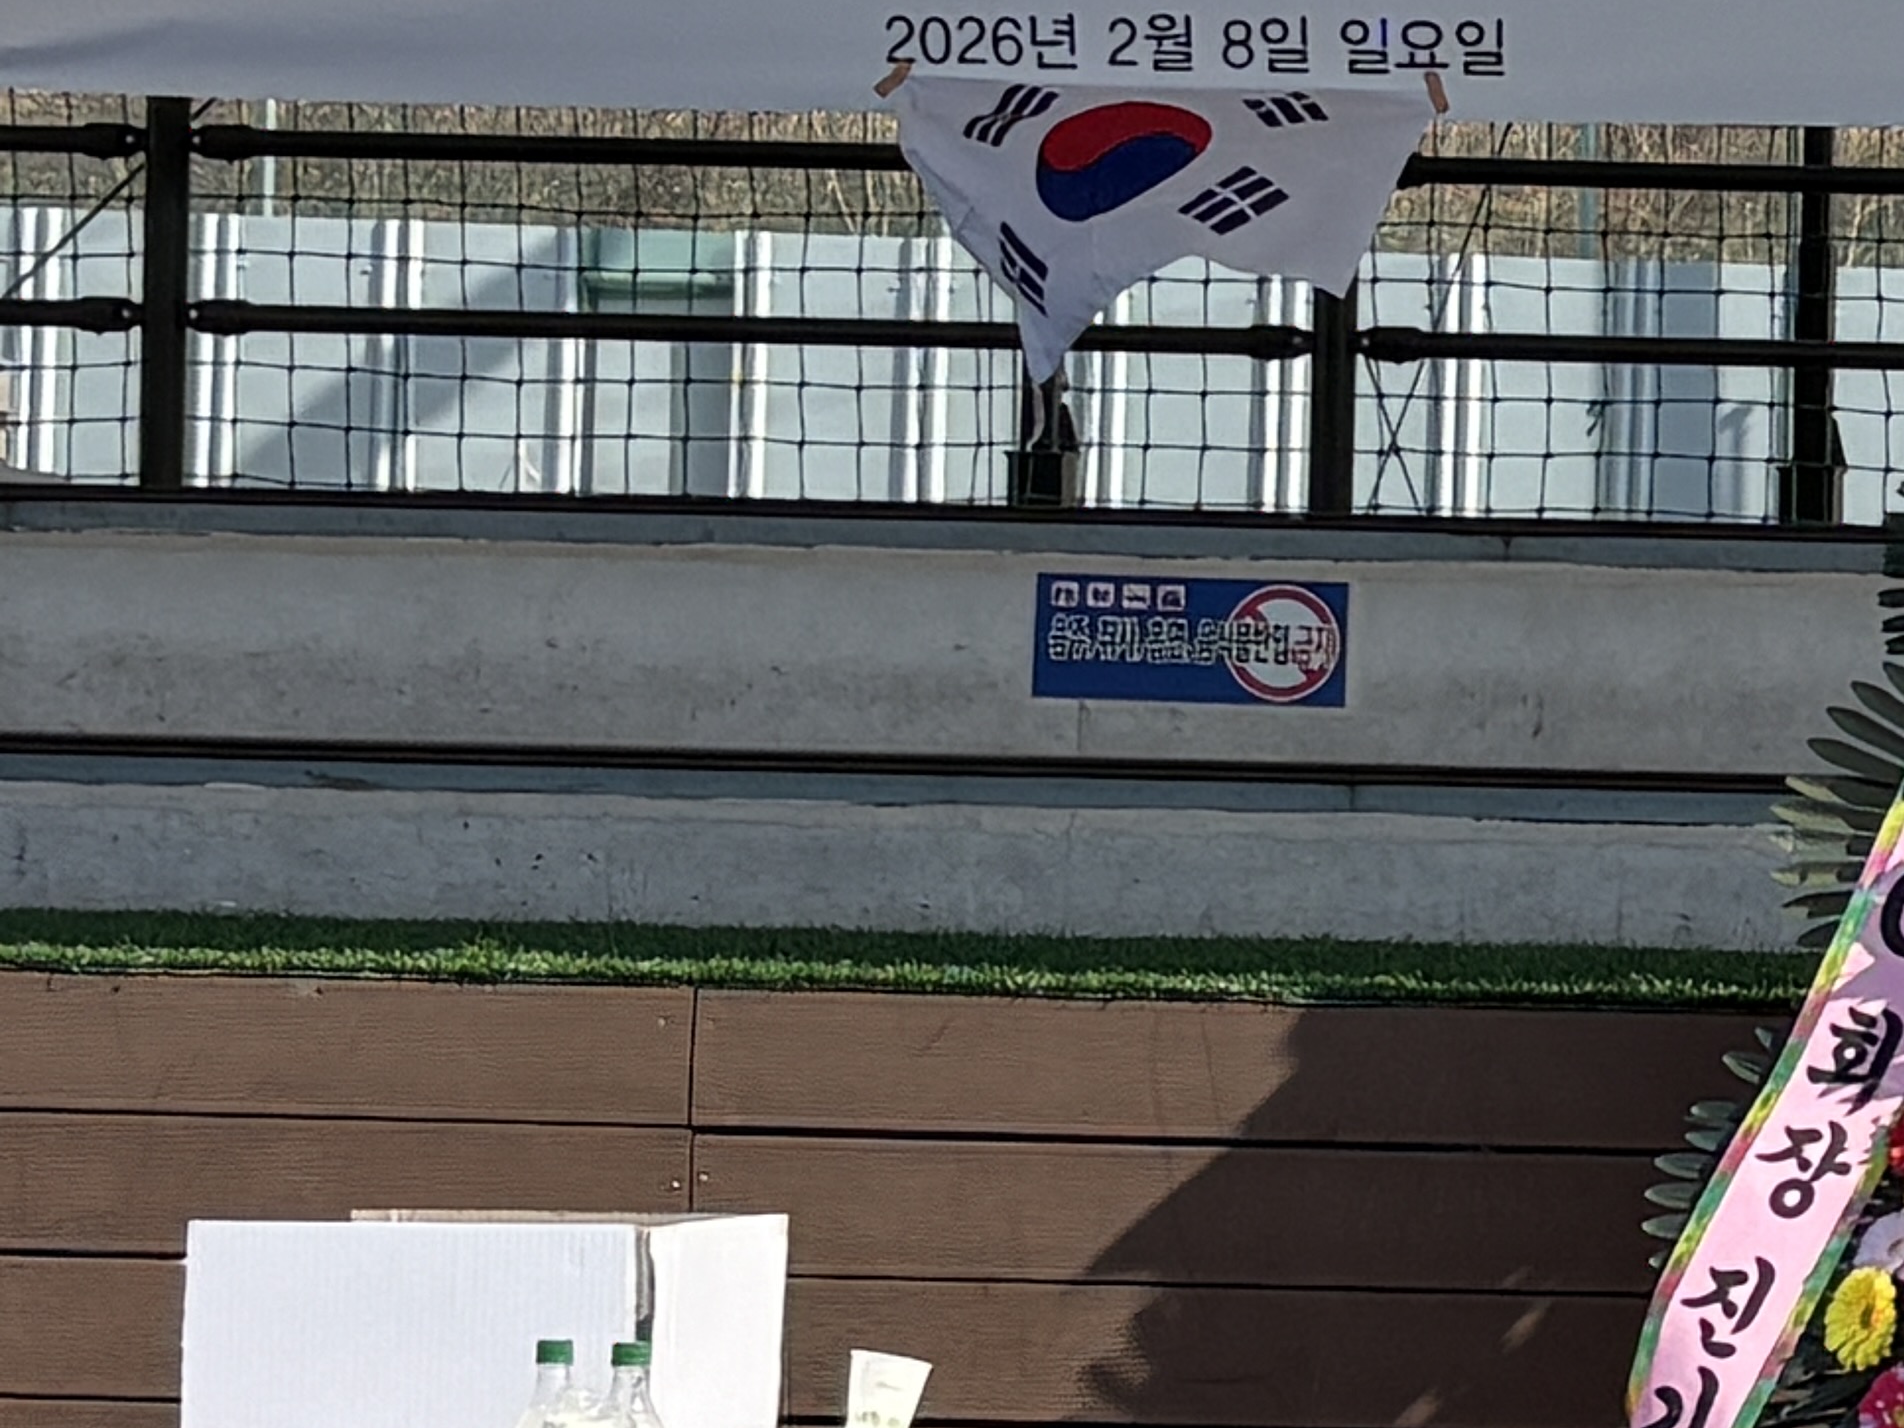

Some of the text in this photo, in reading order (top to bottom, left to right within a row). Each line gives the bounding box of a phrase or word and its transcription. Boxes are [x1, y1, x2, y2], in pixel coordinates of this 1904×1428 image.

[884, 11, 1507, 78] 2026년 2월 8일 일요일
